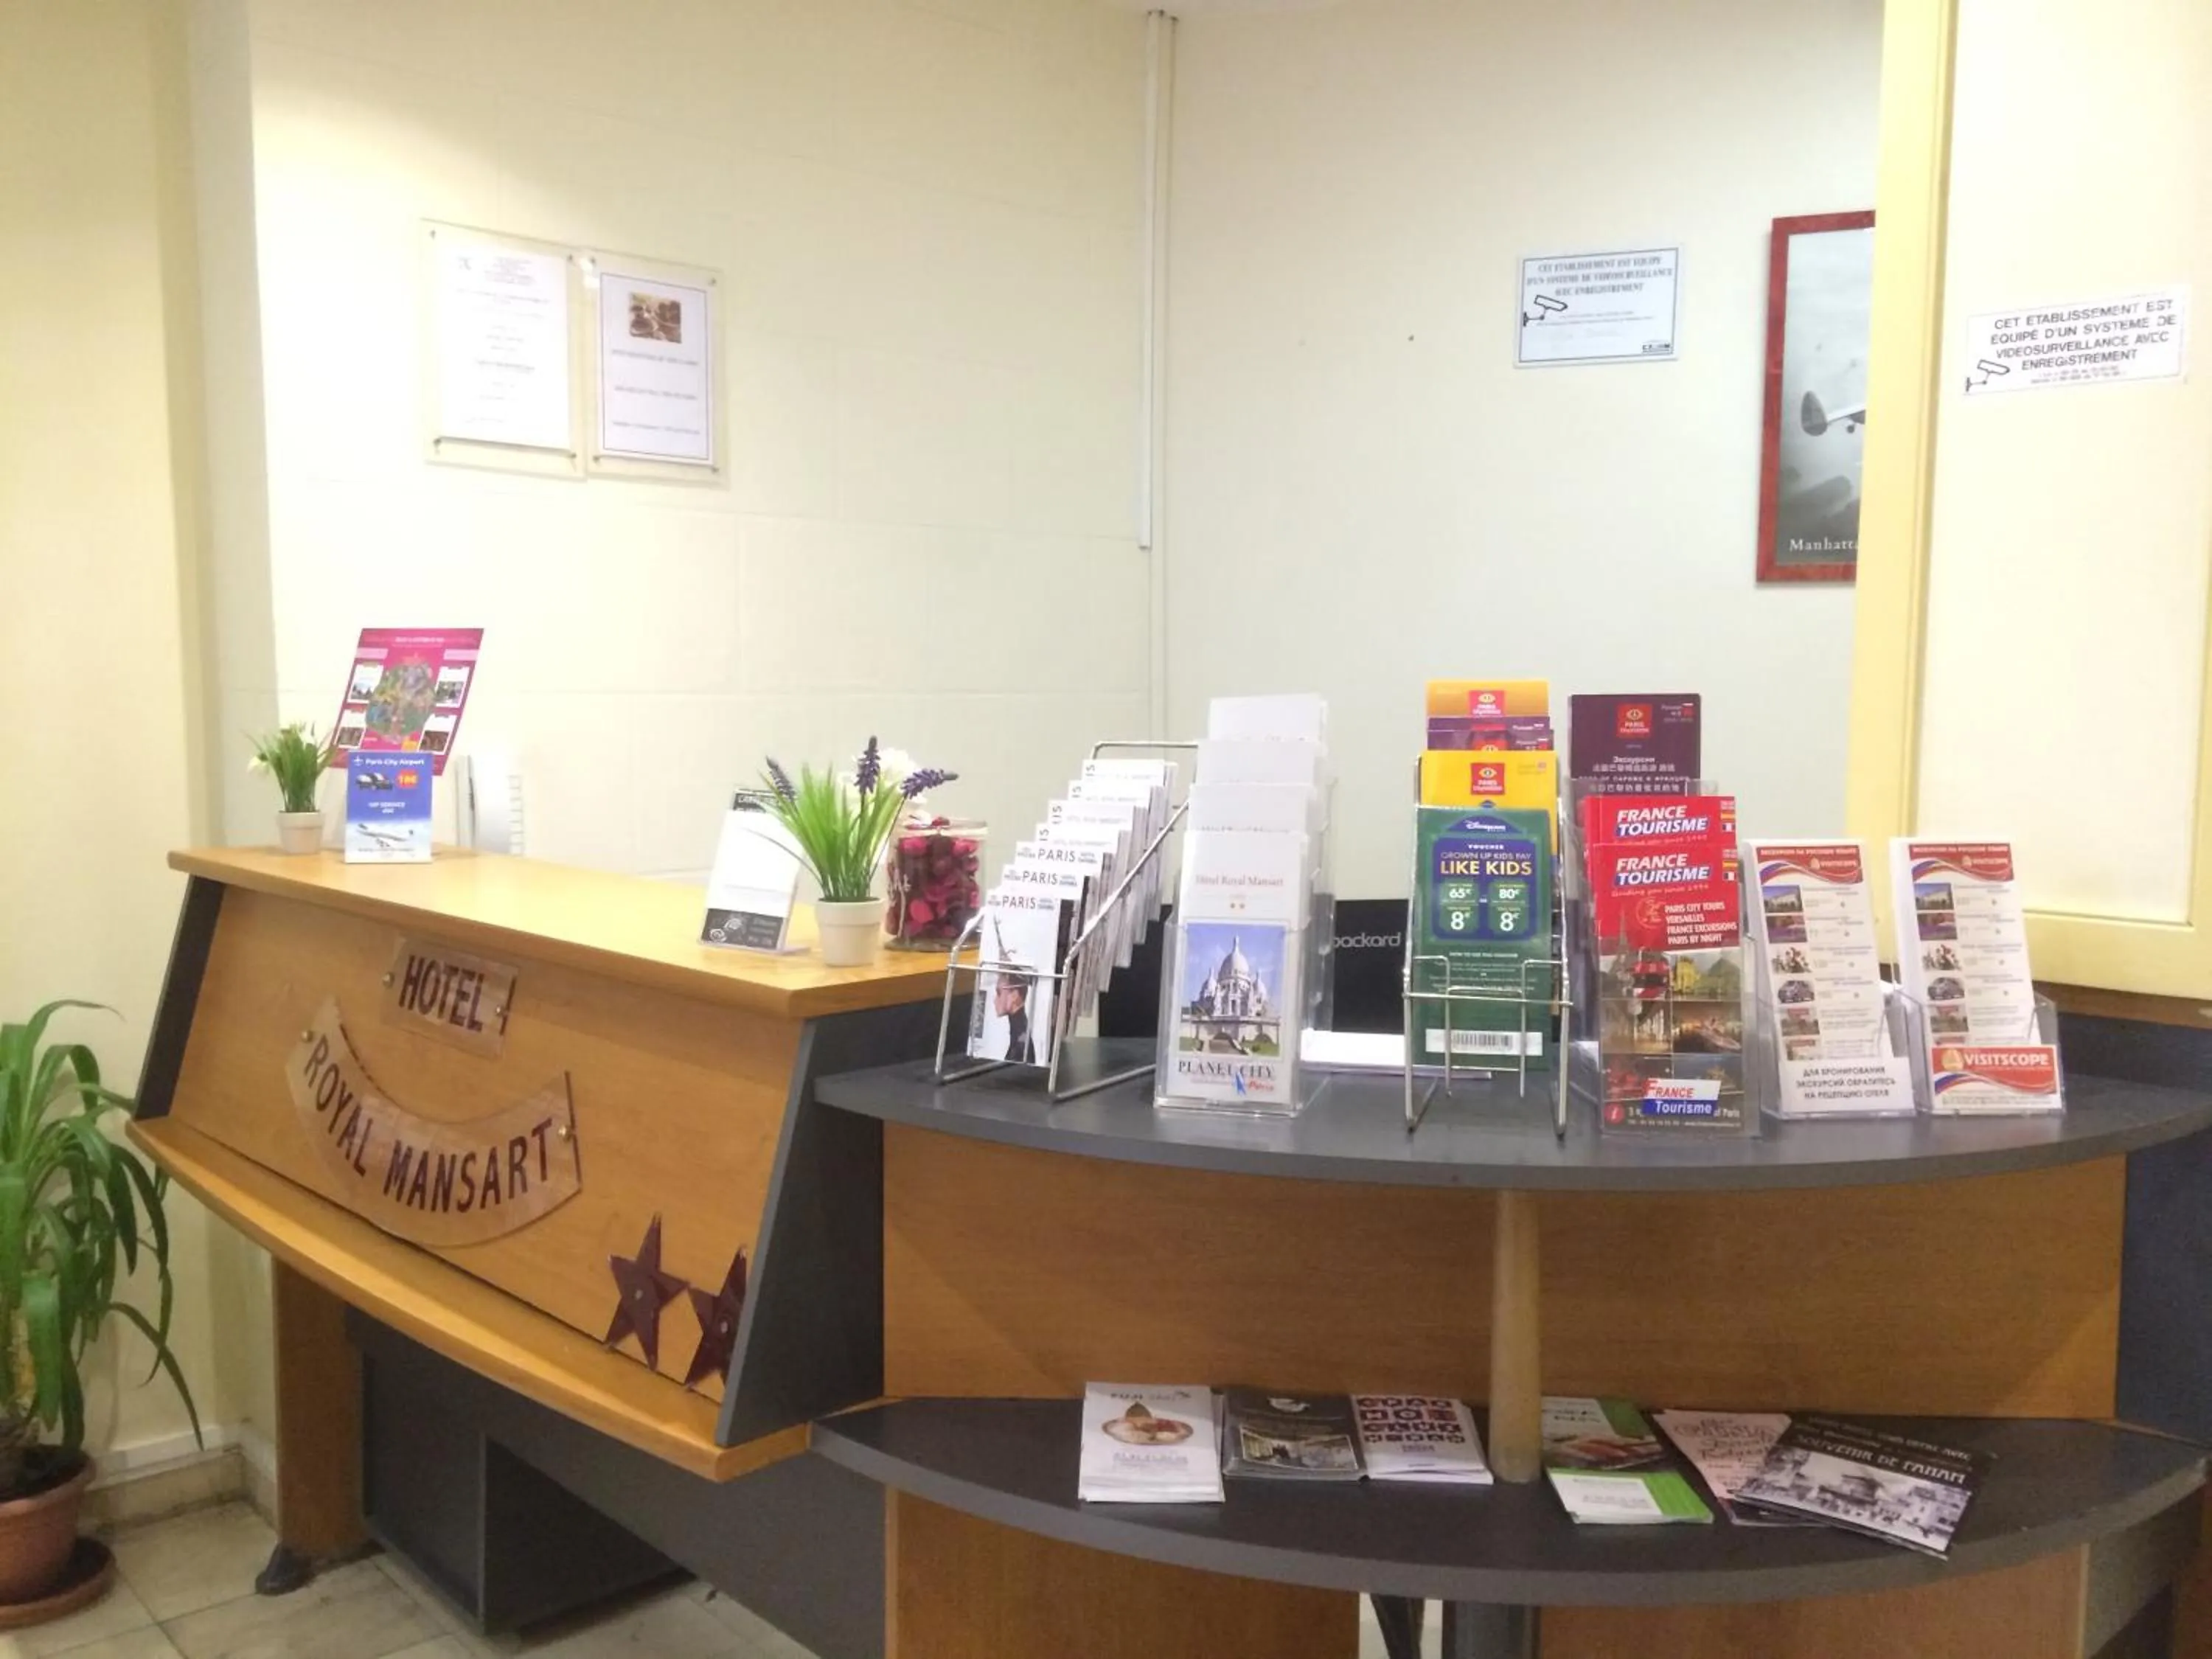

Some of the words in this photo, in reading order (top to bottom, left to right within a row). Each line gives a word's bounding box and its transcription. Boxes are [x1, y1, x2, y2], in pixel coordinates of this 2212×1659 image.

[1994, 317, 2021, 330] CET
[2025, 302, 2140, 326] ETABLISSEMENT
[2146, 299, 2174, 313] EST
[2045, 327, 2078, 339] D'UN
[2083, 317, 2149, 335] SYSTEME
[2156, 314, 2177, 327] DE
[1995, 335, 2129, 359] VIDEOSURVEILLANCE
[2135, 331, 2170, 344] AVEC
[2021, 349, 2138, 371] ENREGISTREMENT
[1617, 805, 1688, 824] FRANCE
[1618, 817, 1708, 837] TOURISME
[1037, 849, 1076, 863] PARIS
[1440, 852, 1478, 860] GROWN
[1616, 853, 1688, 872] FRANCE
[1440, 860, 1481, 874] LIKE
[1486, 860, 1532, 876] KIDS
[1617, 866, 1711, 886] TOURISME
[1022, 870, 1058, 886] PARIS
[1002, 896, 1036, 910] PARIS
[1664, 904, 1686, 914] PARIS
[1687, 903, 1702, 912] CITY
[1666, 914, 1705, 924] VERSAILLES
[1667, 925, 1694, 935] FRANCE
[1694, 922, 1738, 933] EXCURSIONS
[1668, 936, 1688, 945] PARIS
[1700, 933, 1722, 943] NIGHT
[399, 955, 485, 1033] HOTEL
[1964, 1053, 2050, 1066] VISITSCOPE
[1178, 1061, 1232, 1077] PLANET
[1644, 1079, 1694, 1099] FRANCE
[1655, 1101, 1713, 1115] Tourisme
[304, 1034, 373, 1178] ROYAL
[383, 1118, 553, 1214] MANSART
